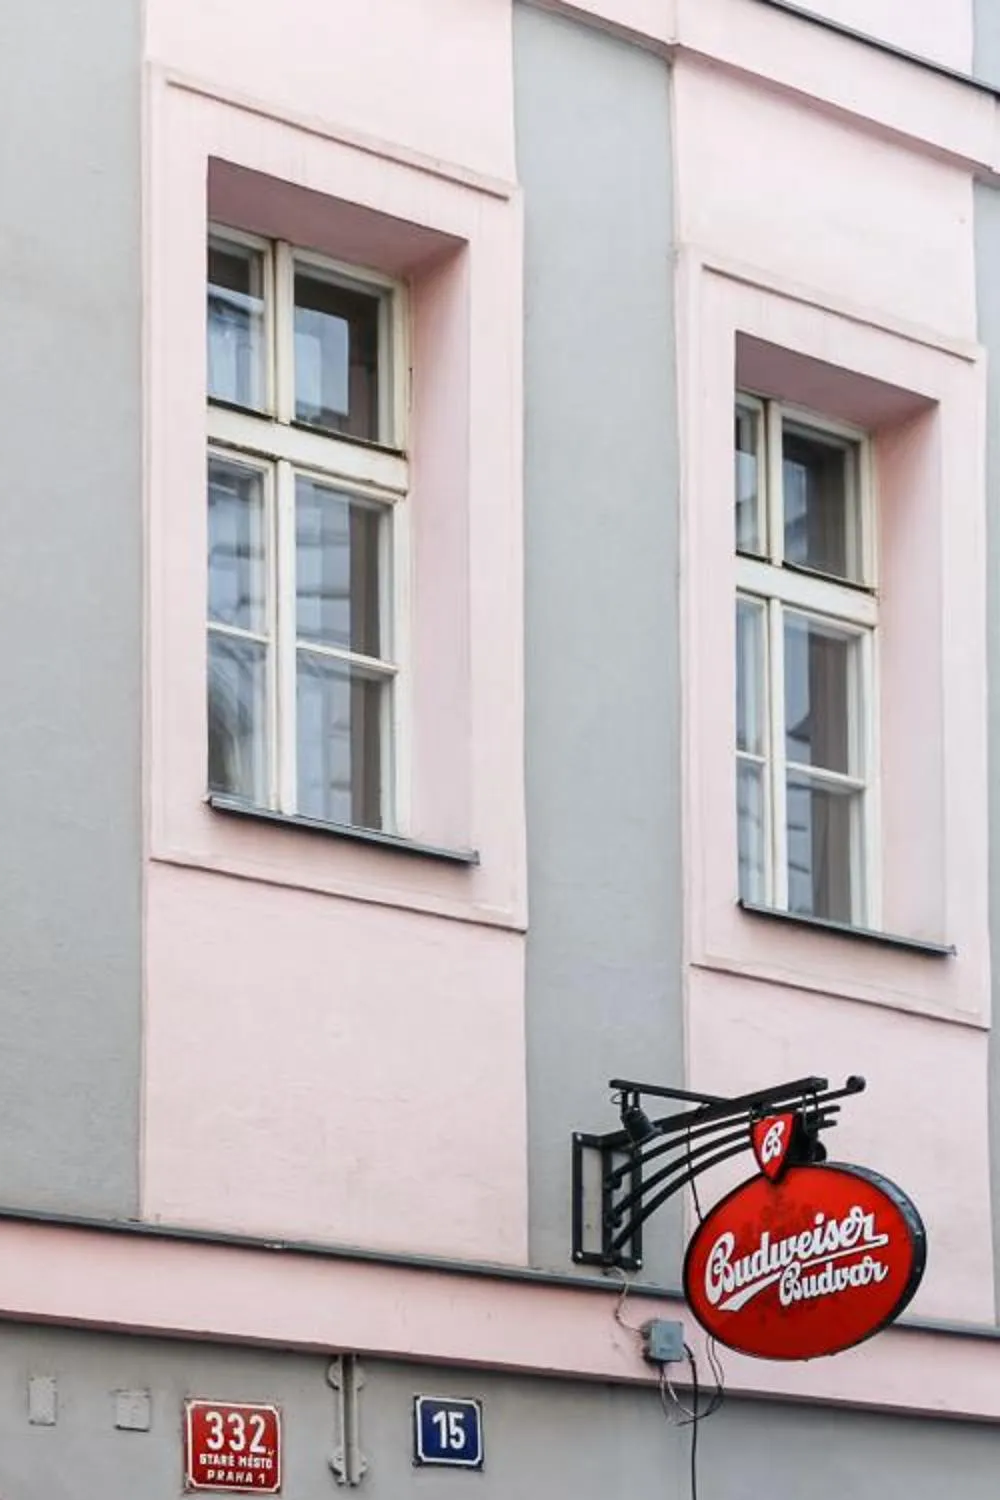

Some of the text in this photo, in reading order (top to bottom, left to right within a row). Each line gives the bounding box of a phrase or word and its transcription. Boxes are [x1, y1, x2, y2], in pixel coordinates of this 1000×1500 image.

[704, 1206, 889, 1306] Budweiser
[779, 1255, 889, 1306] Budvar
[205, 1411, 267, 1454] 332
[432, 1410, 466, 1449] 15
[199, 1452, 235, 1466] STARÉ
[207, 1469, 266, 1484] PRAHA 1
